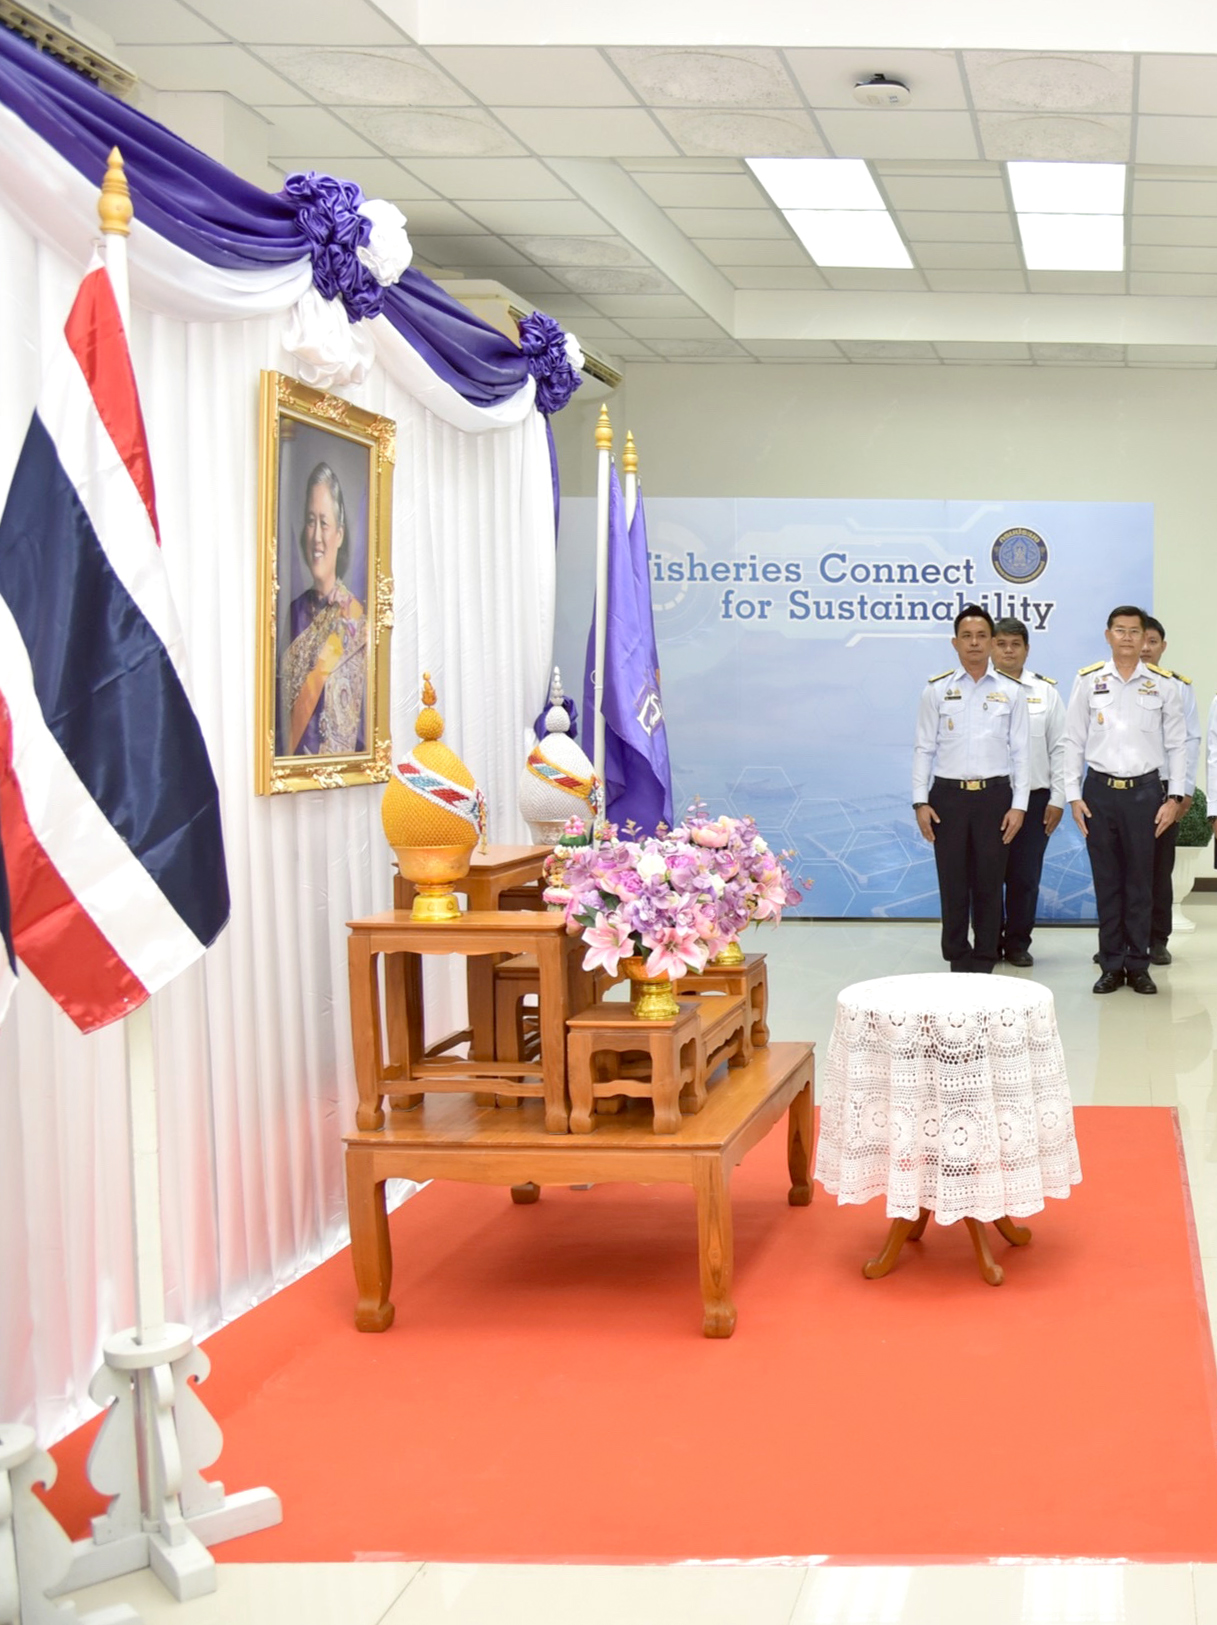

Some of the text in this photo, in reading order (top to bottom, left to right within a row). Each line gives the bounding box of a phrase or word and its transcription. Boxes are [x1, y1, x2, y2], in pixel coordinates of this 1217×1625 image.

[648, 552, 801, 582] isheries
[819, 553, 974, 584] Connect
[721, 590, 772, 619] for
